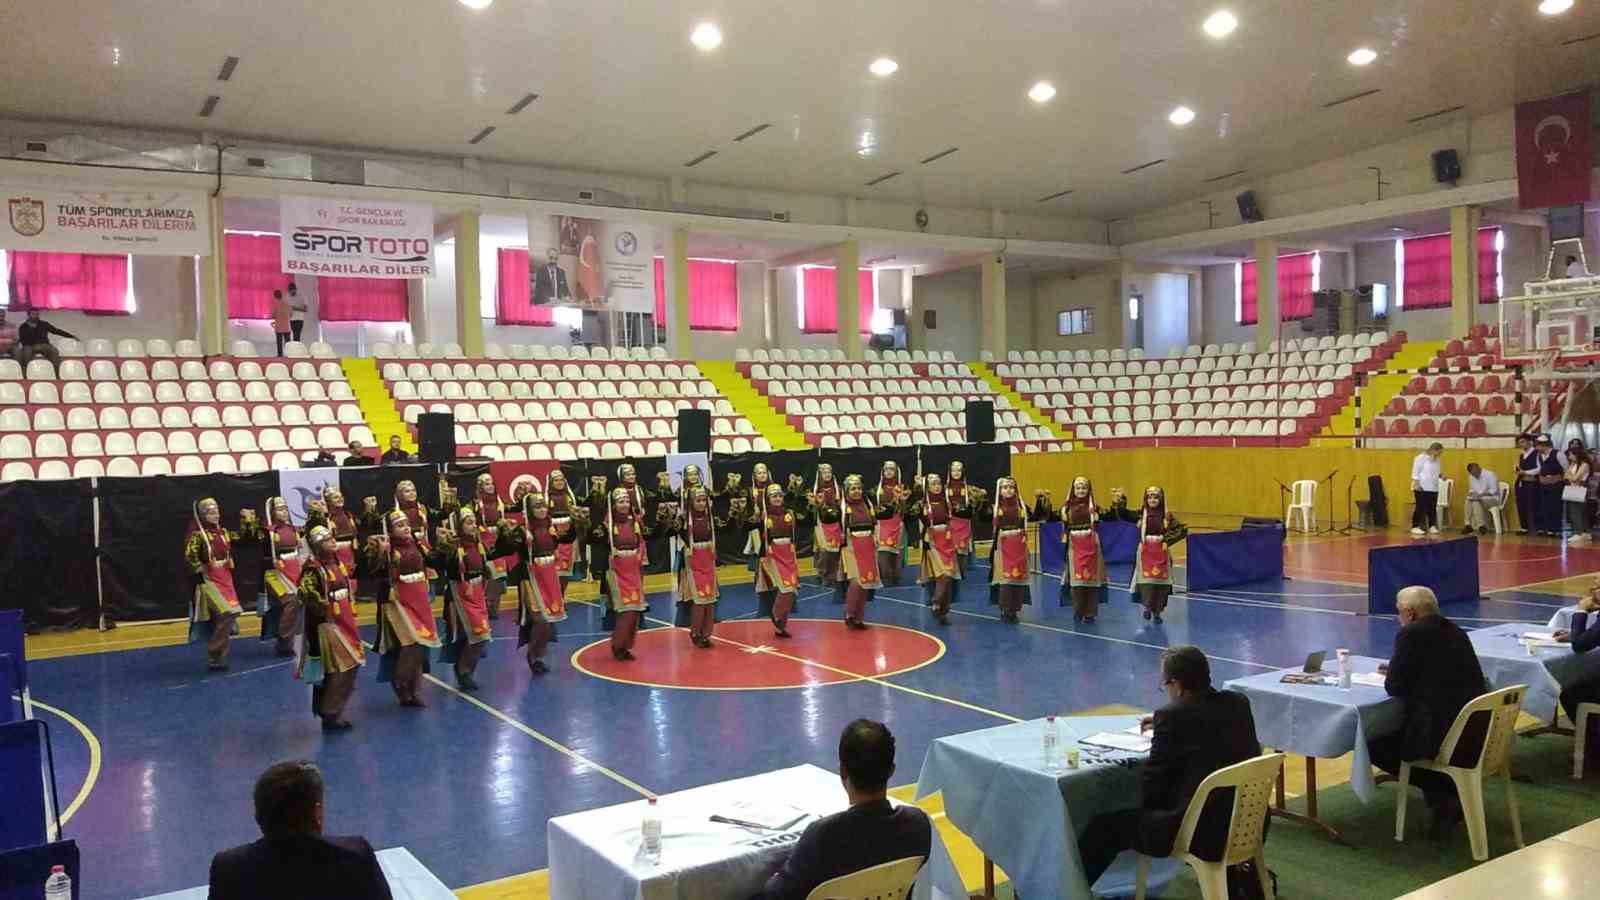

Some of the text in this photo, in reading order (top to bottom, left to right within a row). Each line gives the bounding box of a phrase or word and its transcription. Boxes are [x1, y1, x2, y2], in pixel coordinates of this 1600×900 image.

[89, 205, 195, 219] SPORCULARIMIZA
[57, 216, 138, 230] BAŞARILAR
[288, 259, 431, 275] BAŞARILAR DİLER
